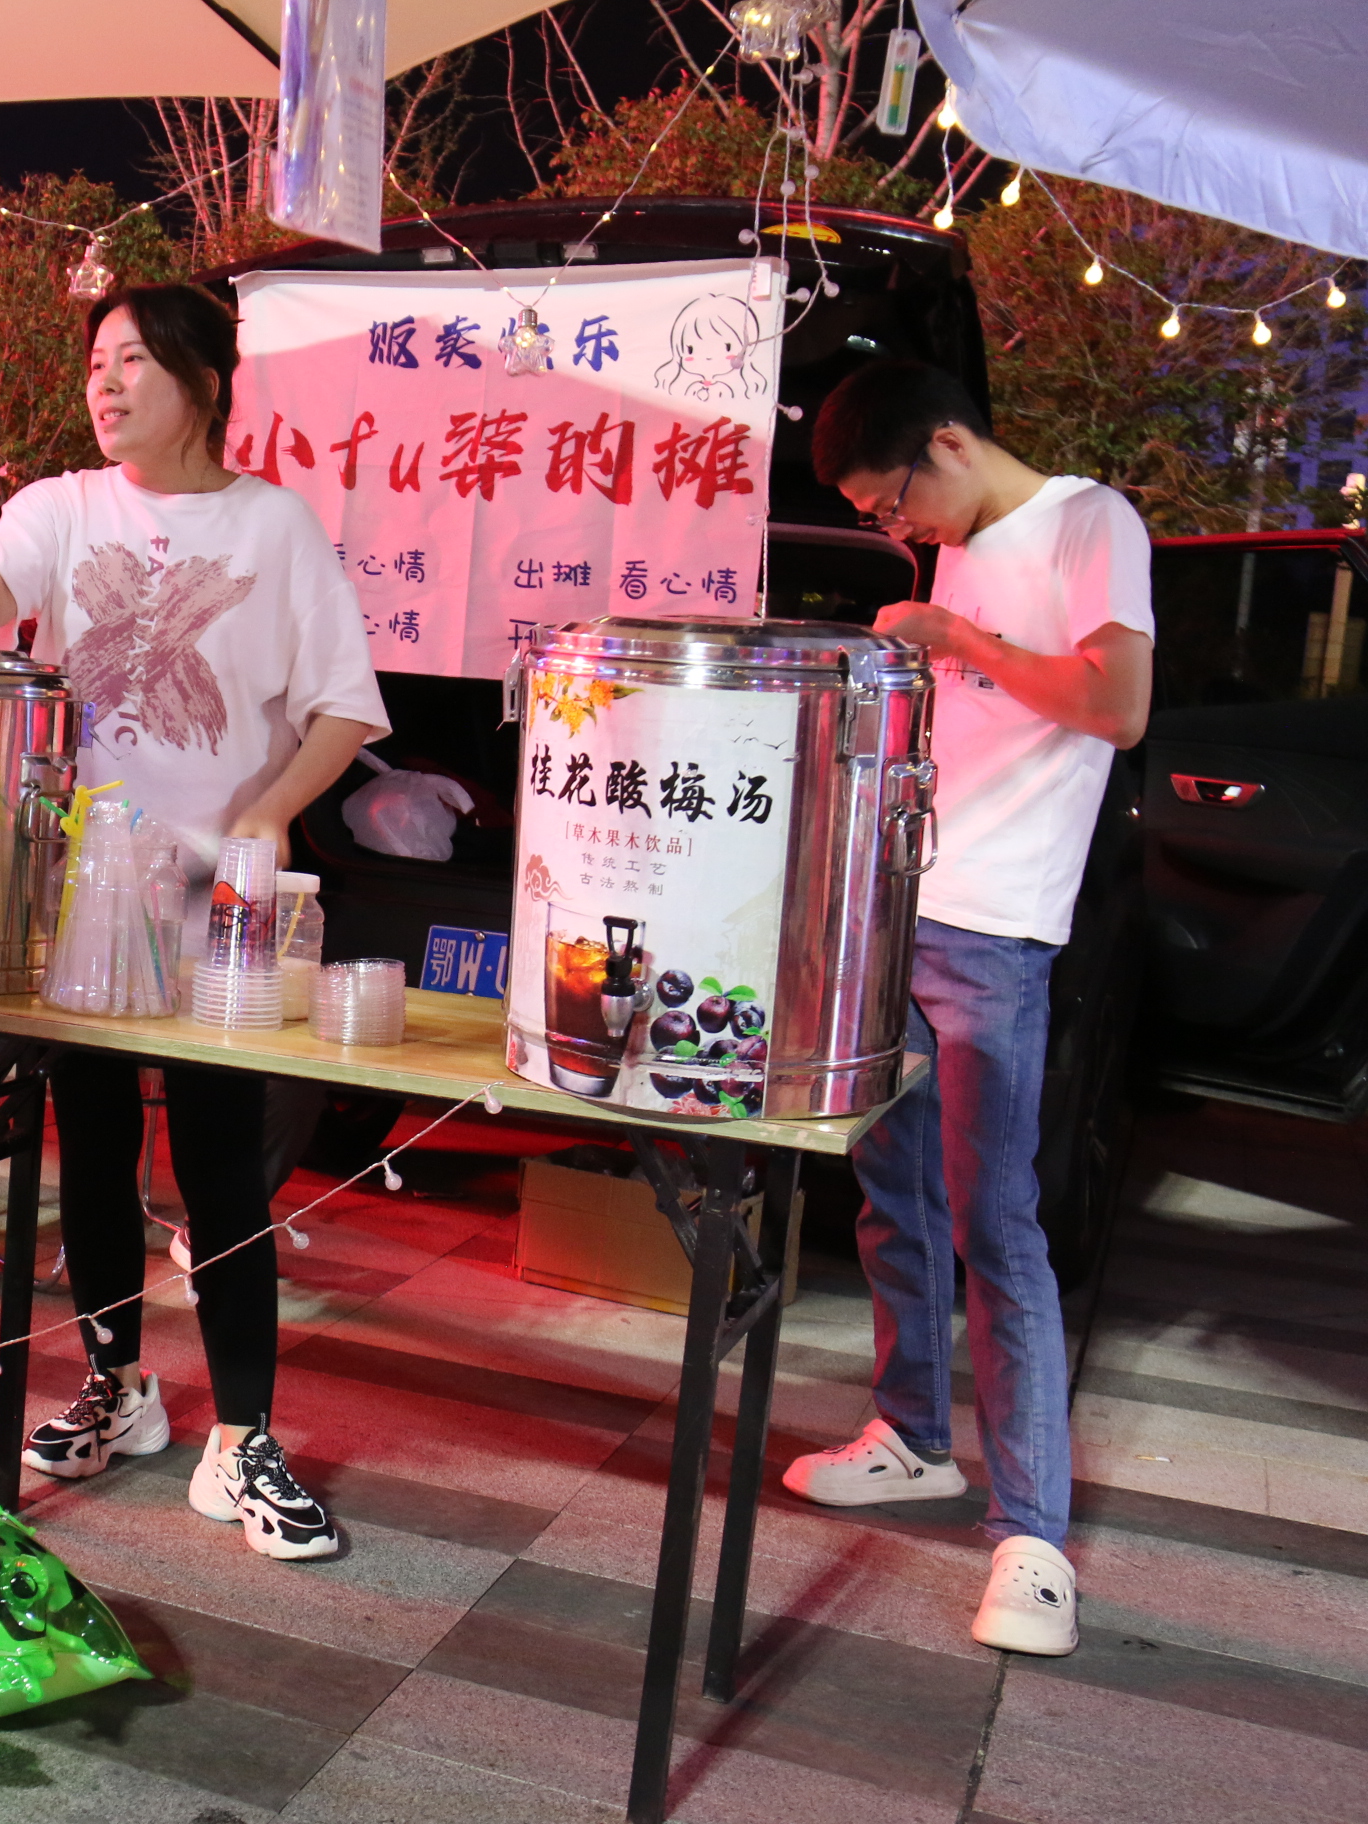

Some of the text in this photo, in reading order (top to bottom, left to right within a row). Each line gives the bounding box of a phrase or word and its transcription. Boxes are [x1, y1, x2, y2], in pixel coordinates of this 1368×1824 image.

[114, 535, 170, 746] FANTASTIC
[530, 742, 774, 824] 桂花酸梅汤
[579, 872, 664, 896] 古法熬制
[581, 852, 667, 876] 传统工艺
